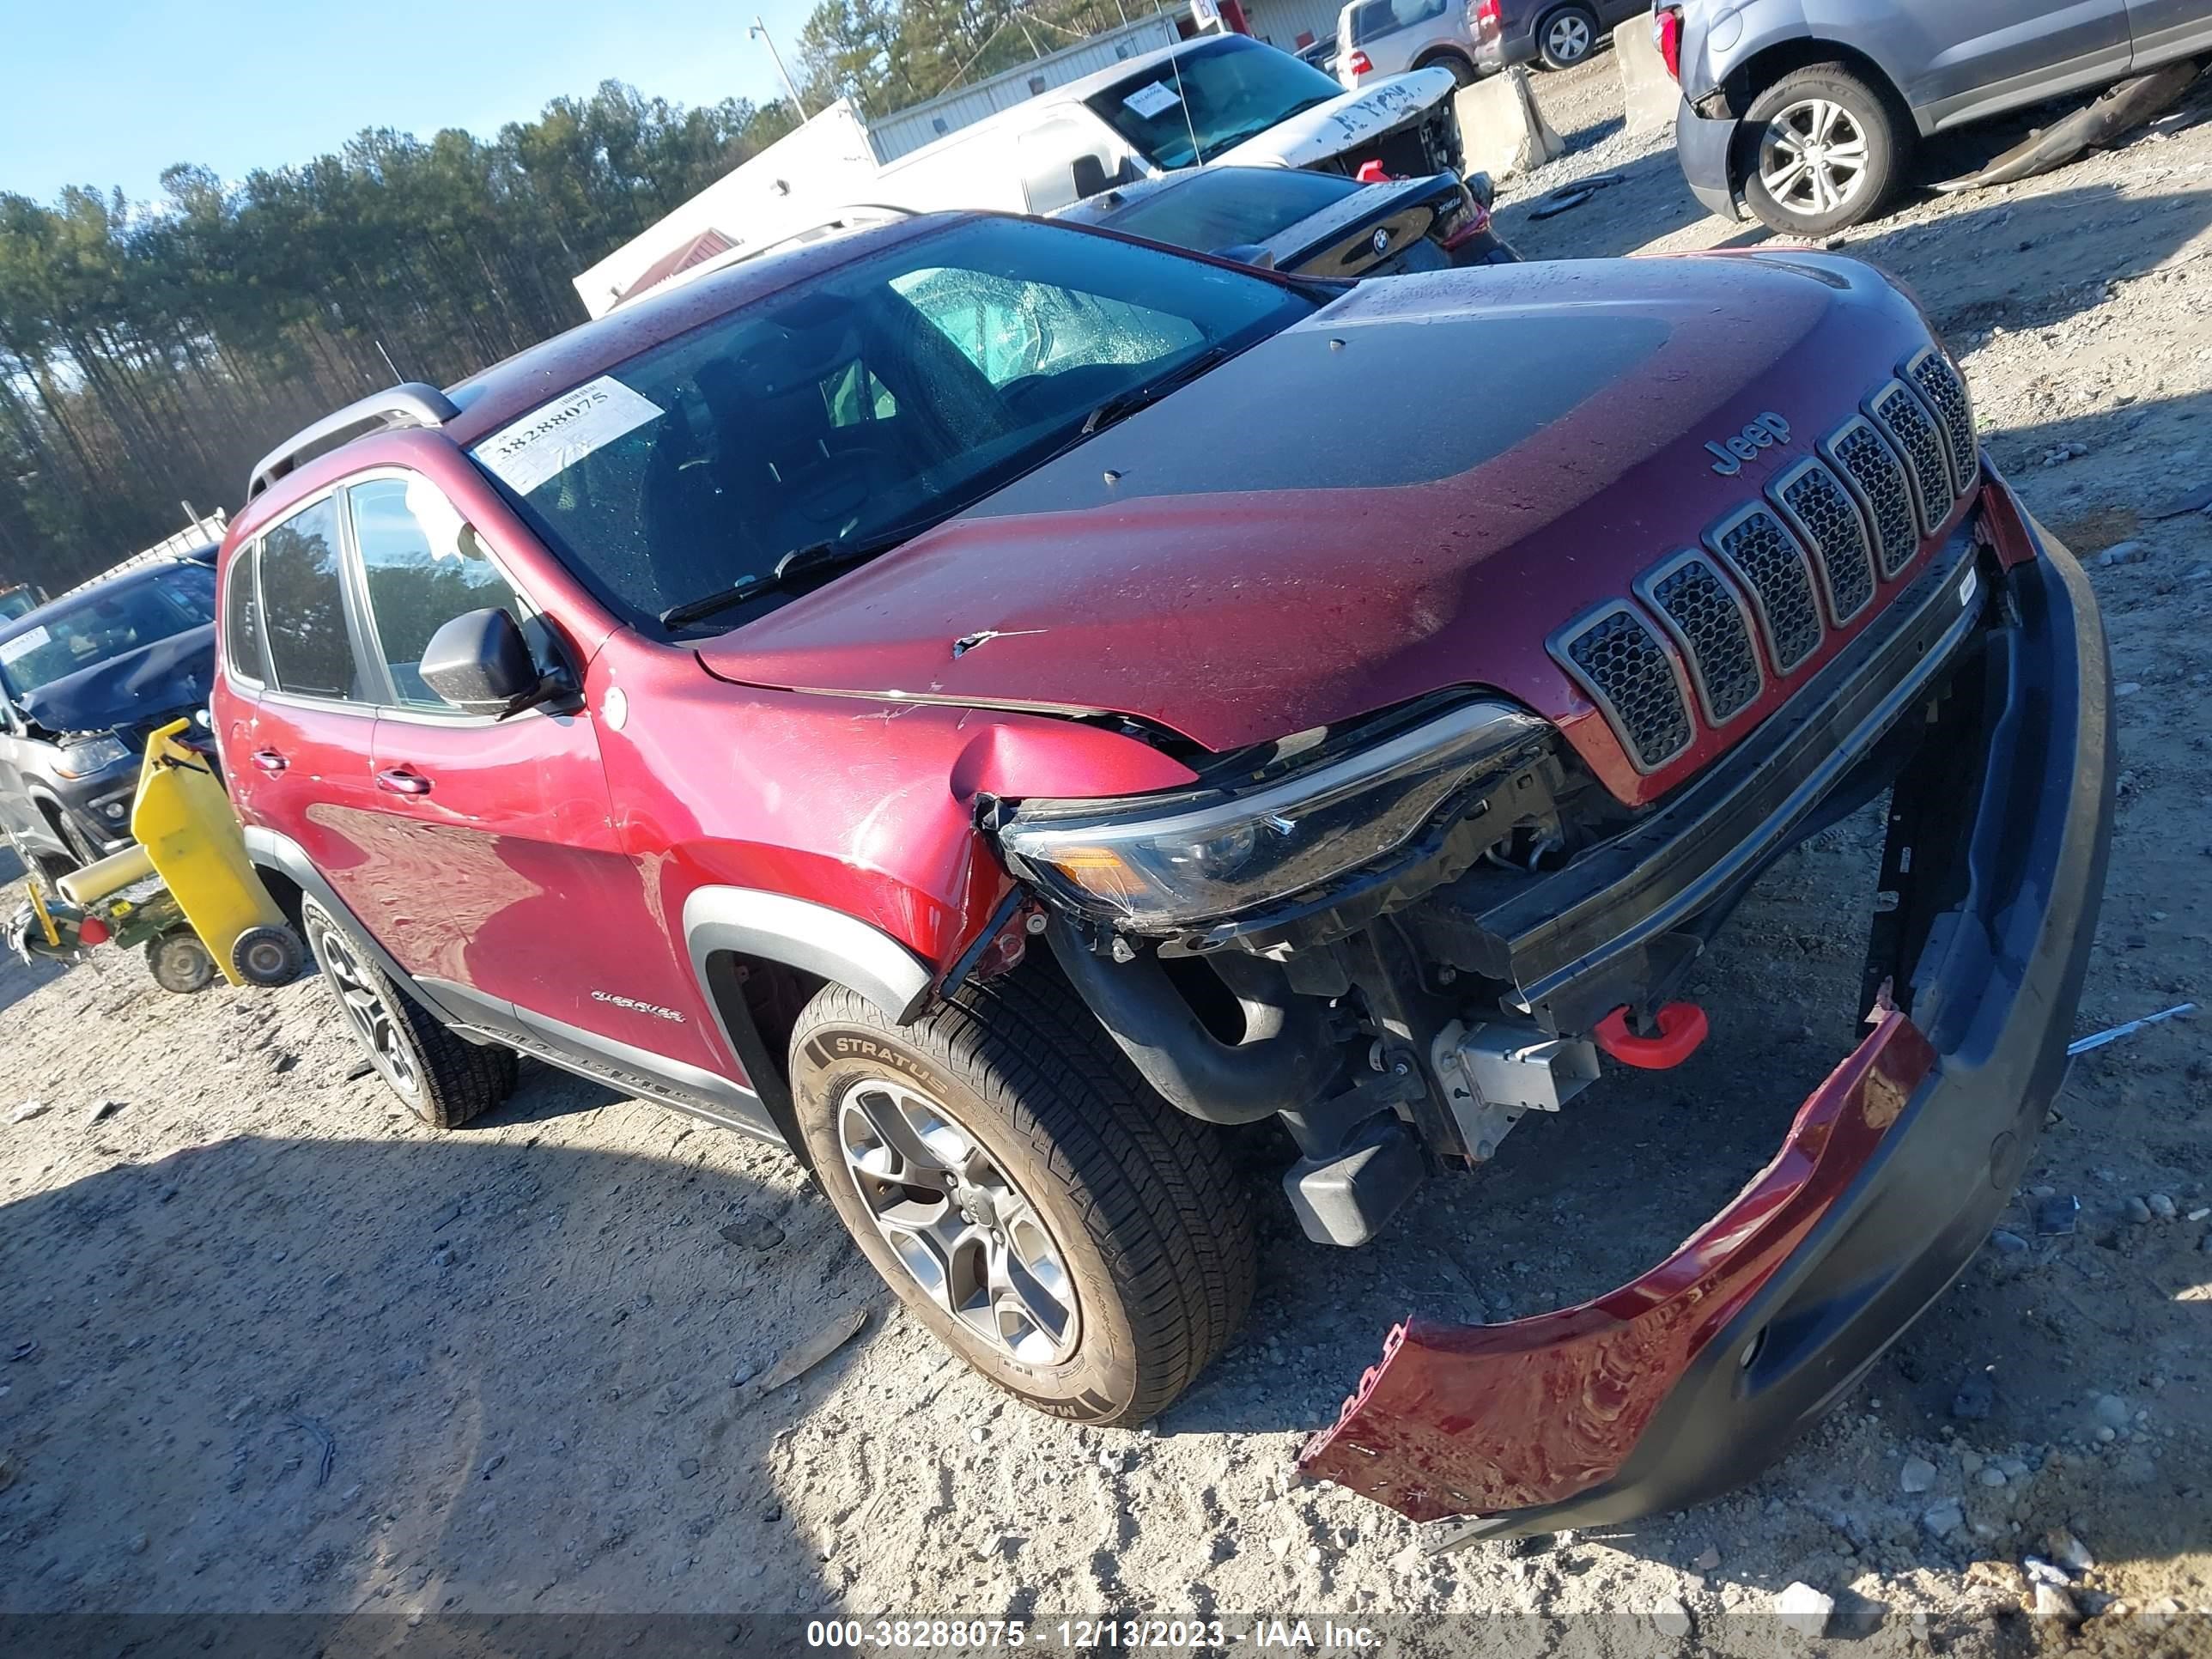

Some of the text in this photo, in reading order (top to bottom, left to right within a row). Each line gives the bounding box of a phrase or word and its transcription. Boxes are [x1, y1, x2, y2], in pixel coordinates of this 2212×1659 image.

[495, 392, 609, 460] 38288075
[1703, 411, 1791, 476] Jeep
[836, 1036, 950, 1095] STRATUS
